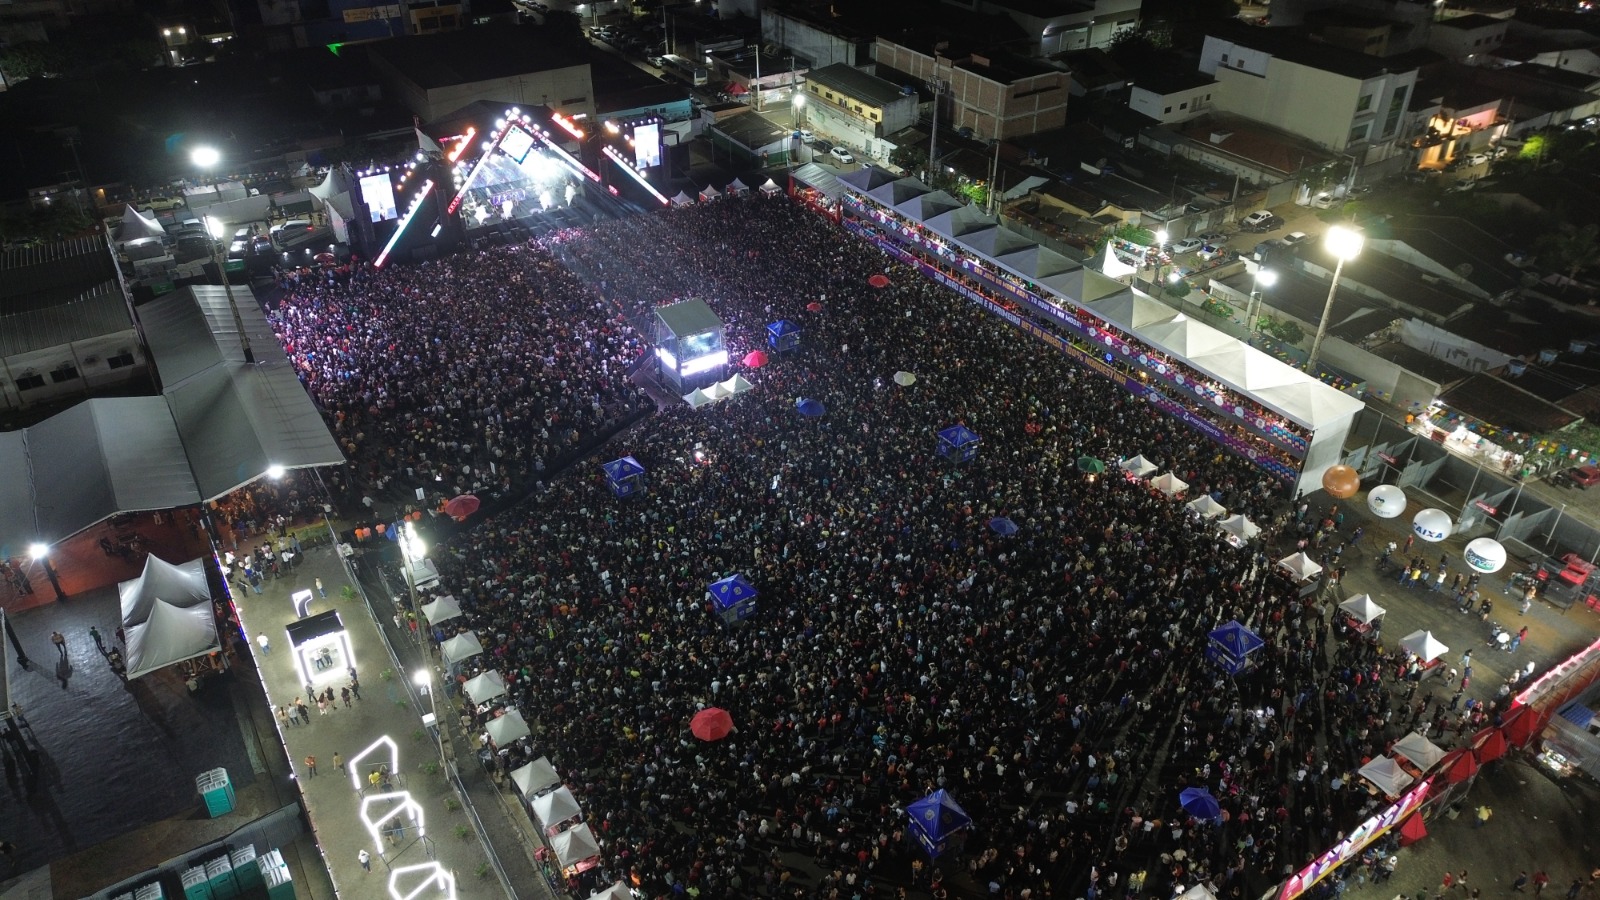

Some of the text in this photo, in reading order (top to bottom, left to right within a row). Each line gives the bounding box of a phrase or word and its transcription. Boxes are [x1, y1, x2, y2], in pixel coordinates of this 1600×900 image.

[967, 290, 984, 305] MODA
[993, 305, 1020, 325] PRIMEIRA
[1021, 320, 1032, 331] BET
[1033, 326, 1041, 338] DO
[1041, 331, 1063, 350] BRASIL
[1065, 345, 1083, 362] 100%
[1084, 356, 1126, 386] NORDESTINA
[1413, 522, 1443, 538] CAIXA
